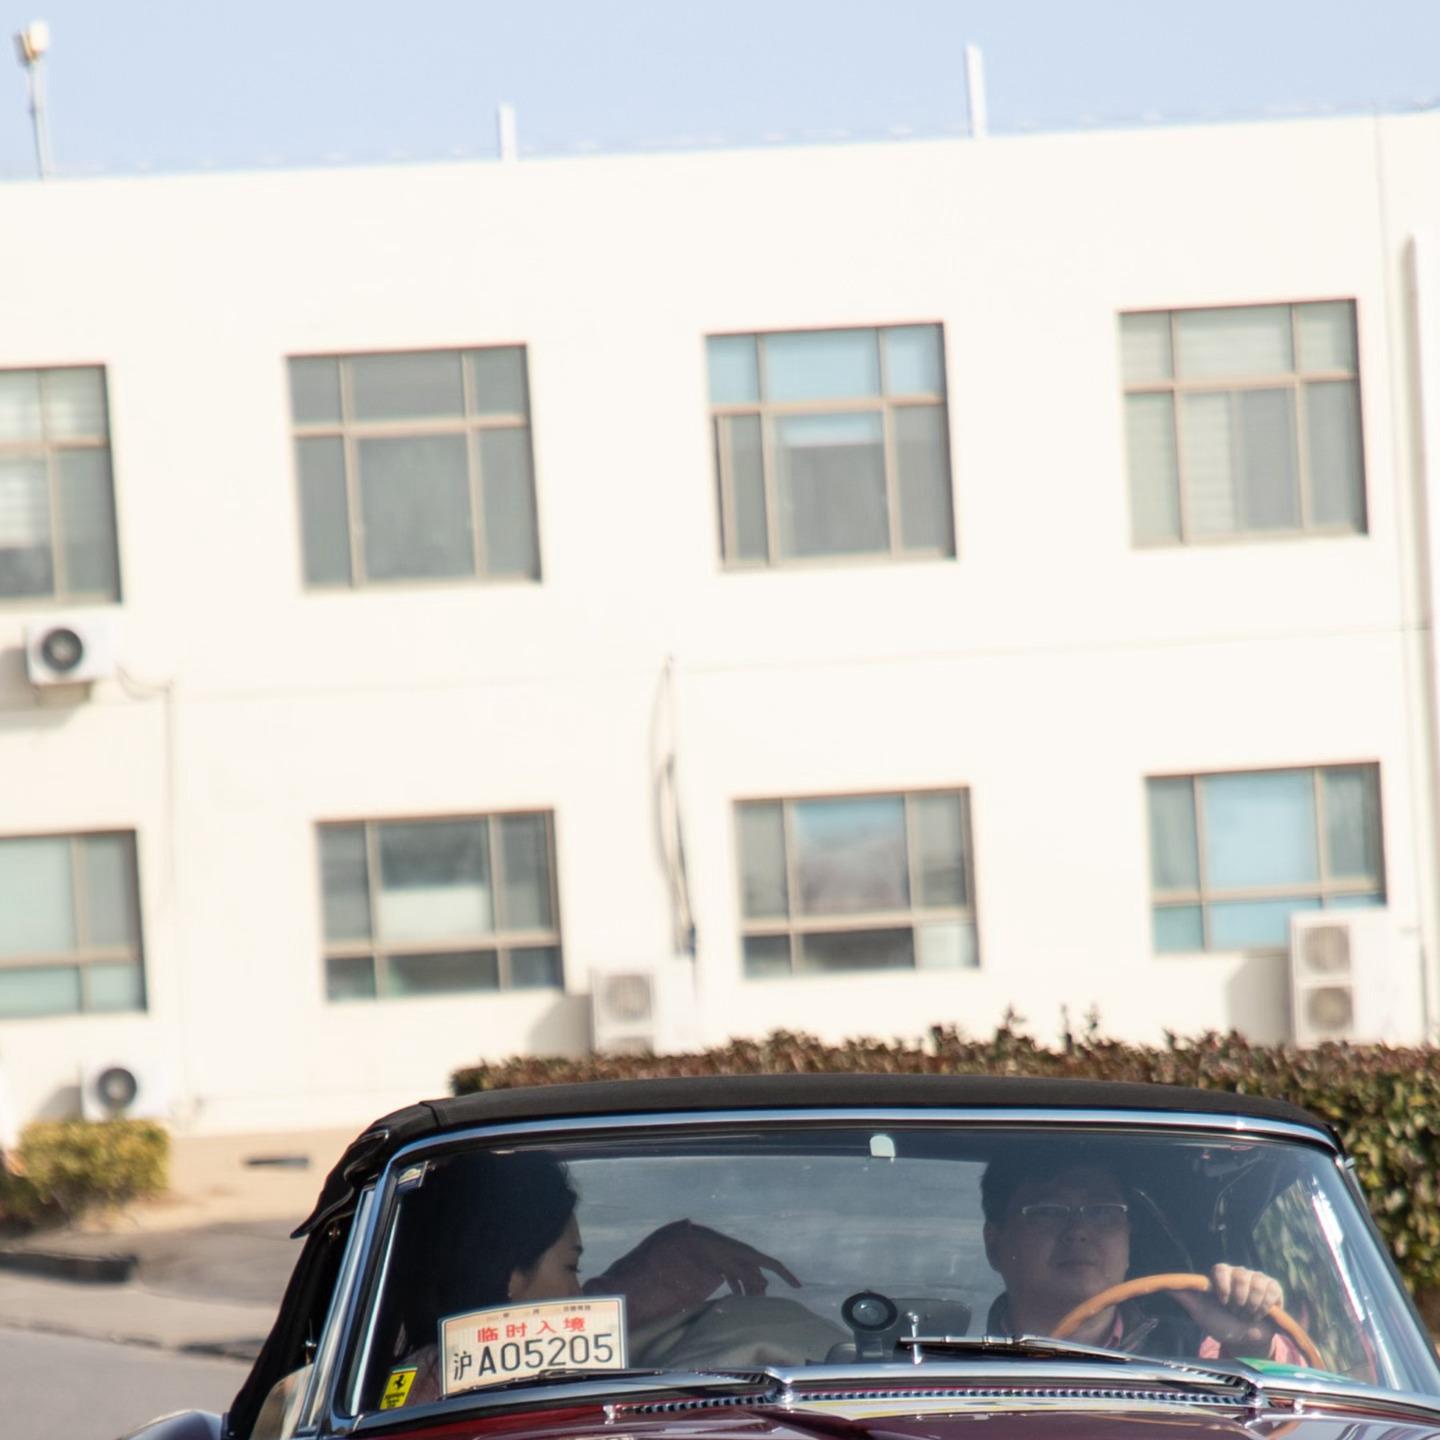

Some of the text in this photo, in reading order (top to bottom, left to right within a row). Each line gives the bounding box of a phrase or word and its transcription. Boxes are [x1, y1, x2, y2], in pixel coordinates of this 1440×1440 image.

[477, 1316, 587, 1343] 临时入境
[453, 1333, 613, 1381] 沪A05205
